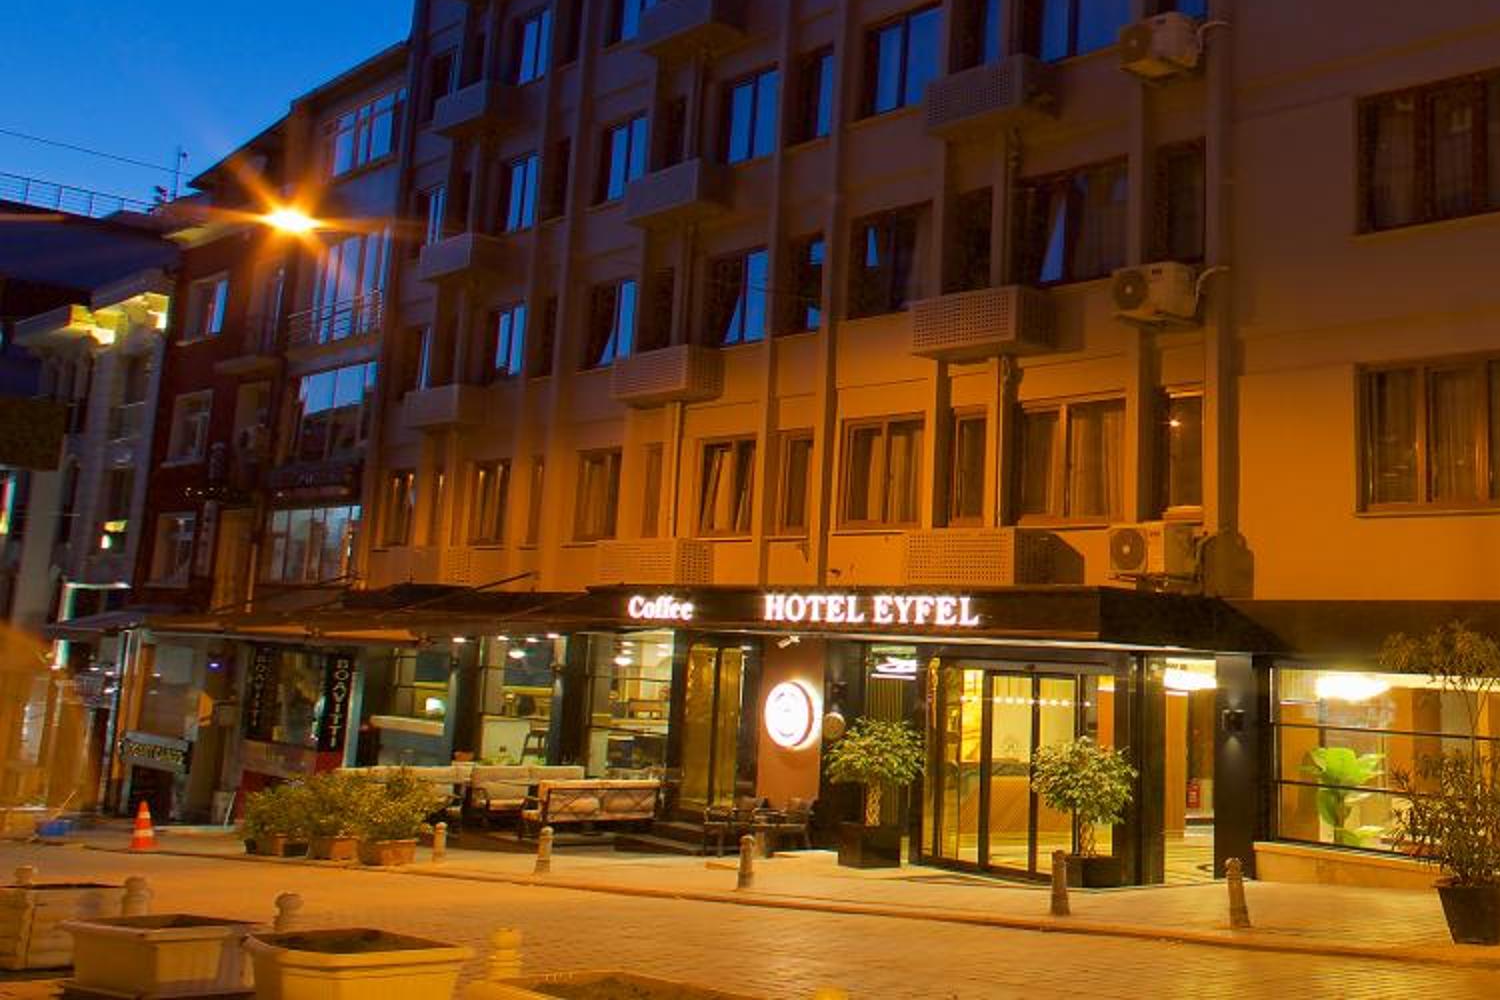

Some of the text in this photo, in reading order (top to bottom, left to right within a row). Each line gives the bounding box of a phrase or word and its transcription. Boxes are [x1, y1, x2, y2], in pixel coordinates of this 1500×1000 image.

[627, 596, 695, 620] Coffee
[763, 594, 979, 626] HOTEL EYFEL
